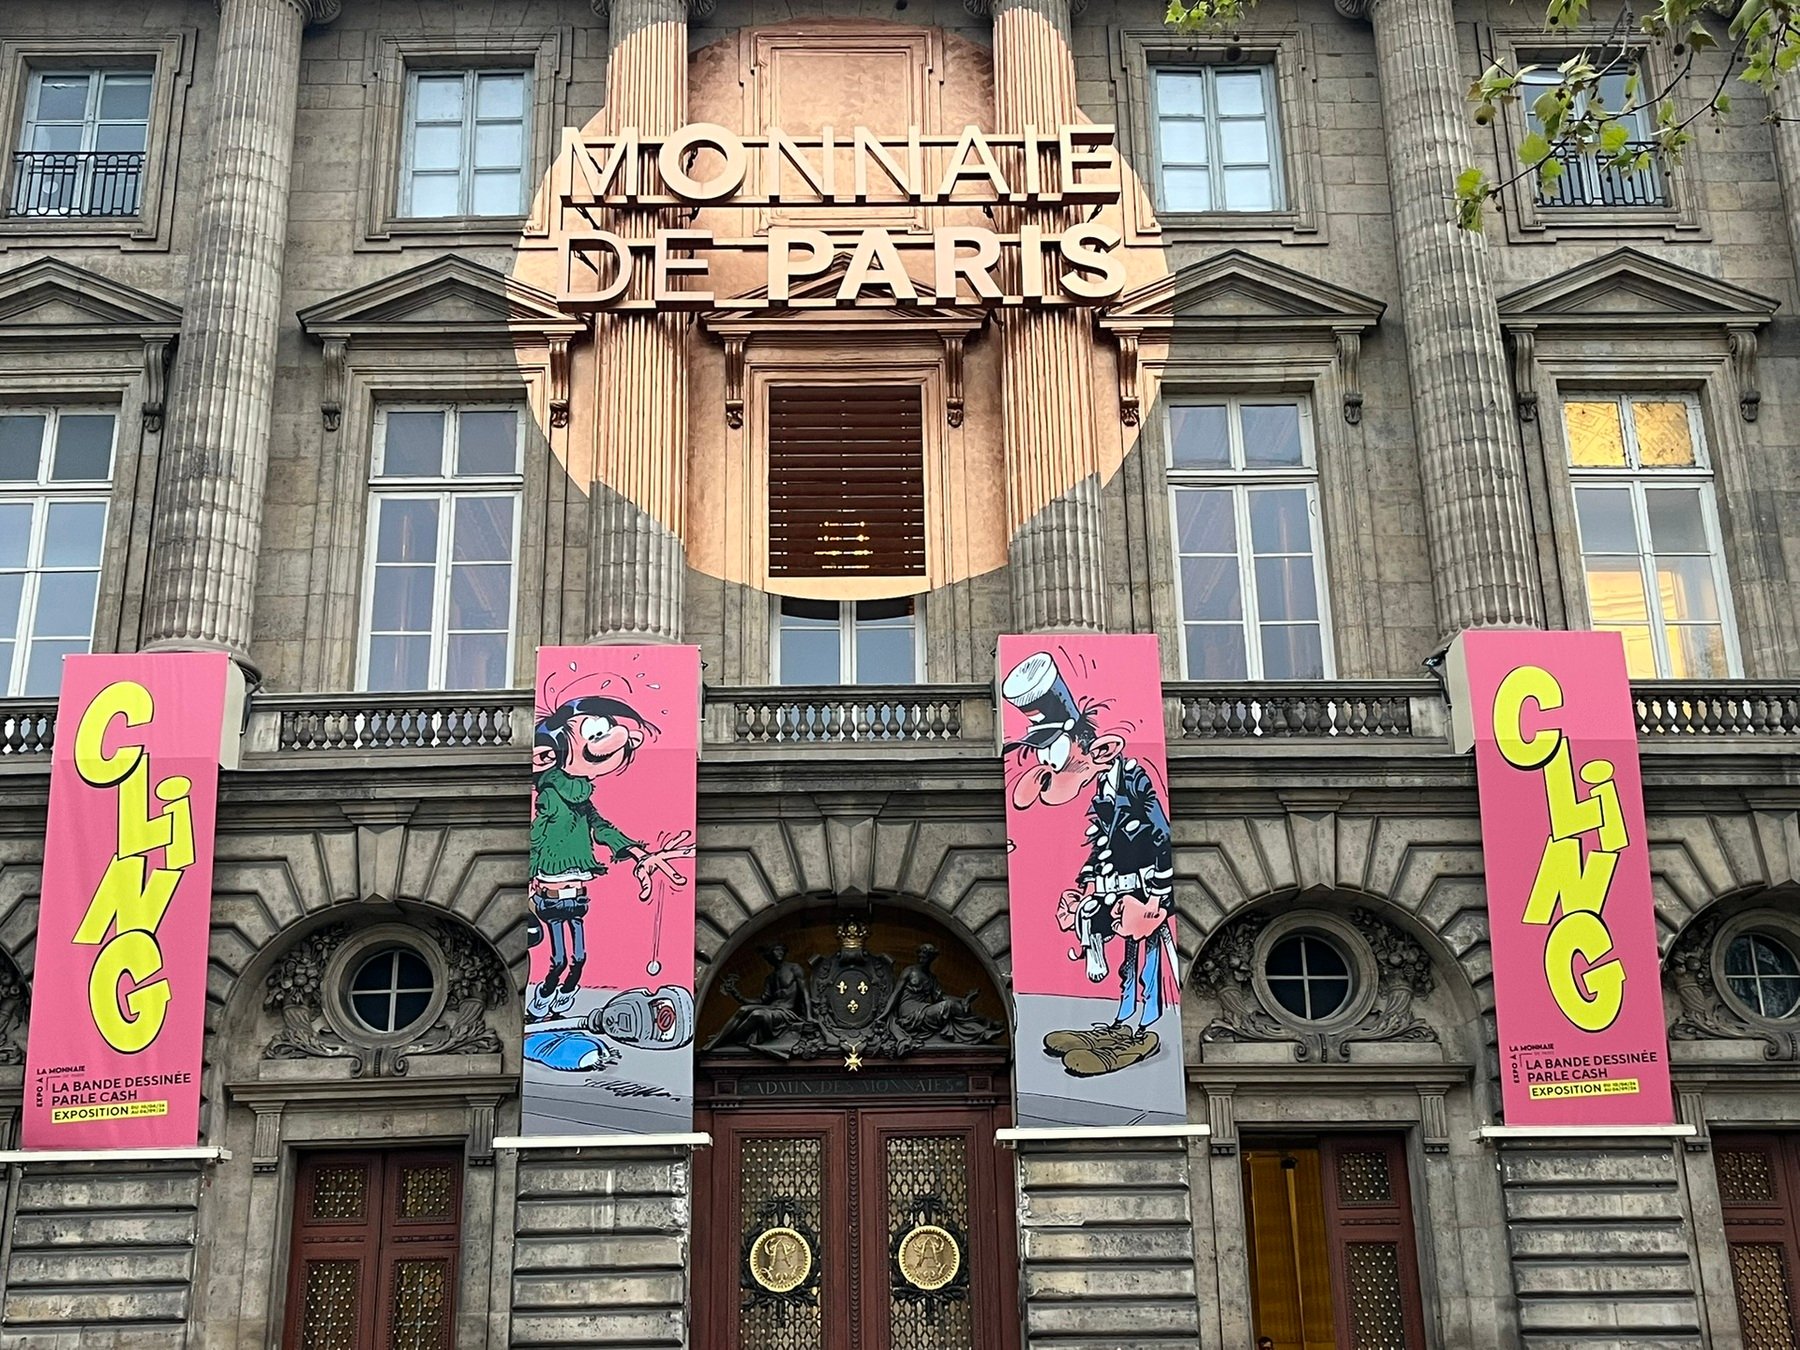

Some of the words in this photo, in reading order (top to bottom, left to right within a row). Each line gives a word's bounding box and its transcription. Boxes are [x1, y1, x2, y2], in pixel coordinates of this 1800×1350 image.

[560, 122, 1121, 204] MONNAIE
[557, 228, 715, 310] DE
[766, 223, 1127, 308] PARIS
[1520, 1043, 1554, 1051] MONNAIE
[1526, 1060, 1543, 1070] LA
[1546, 1056, 1590, 1069] BANDE
[1593, 1050, 1658, 1066] DESSINÉE
[49, 1065, 85, 1074] MONNAIE
[1527, 1070, 1569, 1083] PARLE
[1572, 1068, 1608, 1081] CASH
[52, 1082, 69, 1093] LA
[73, 1078, 121, 1091] BANDE
[125, 1070, 191, 1088] DESSINÉE
[1532, 1083, 1602, 1097] EXPOSITION
[52, 1093, 96, 1106] PARLE
[99, 1090, 137, 1103] CASH
[54, 1106, 129, 1121] EXPOSITION
